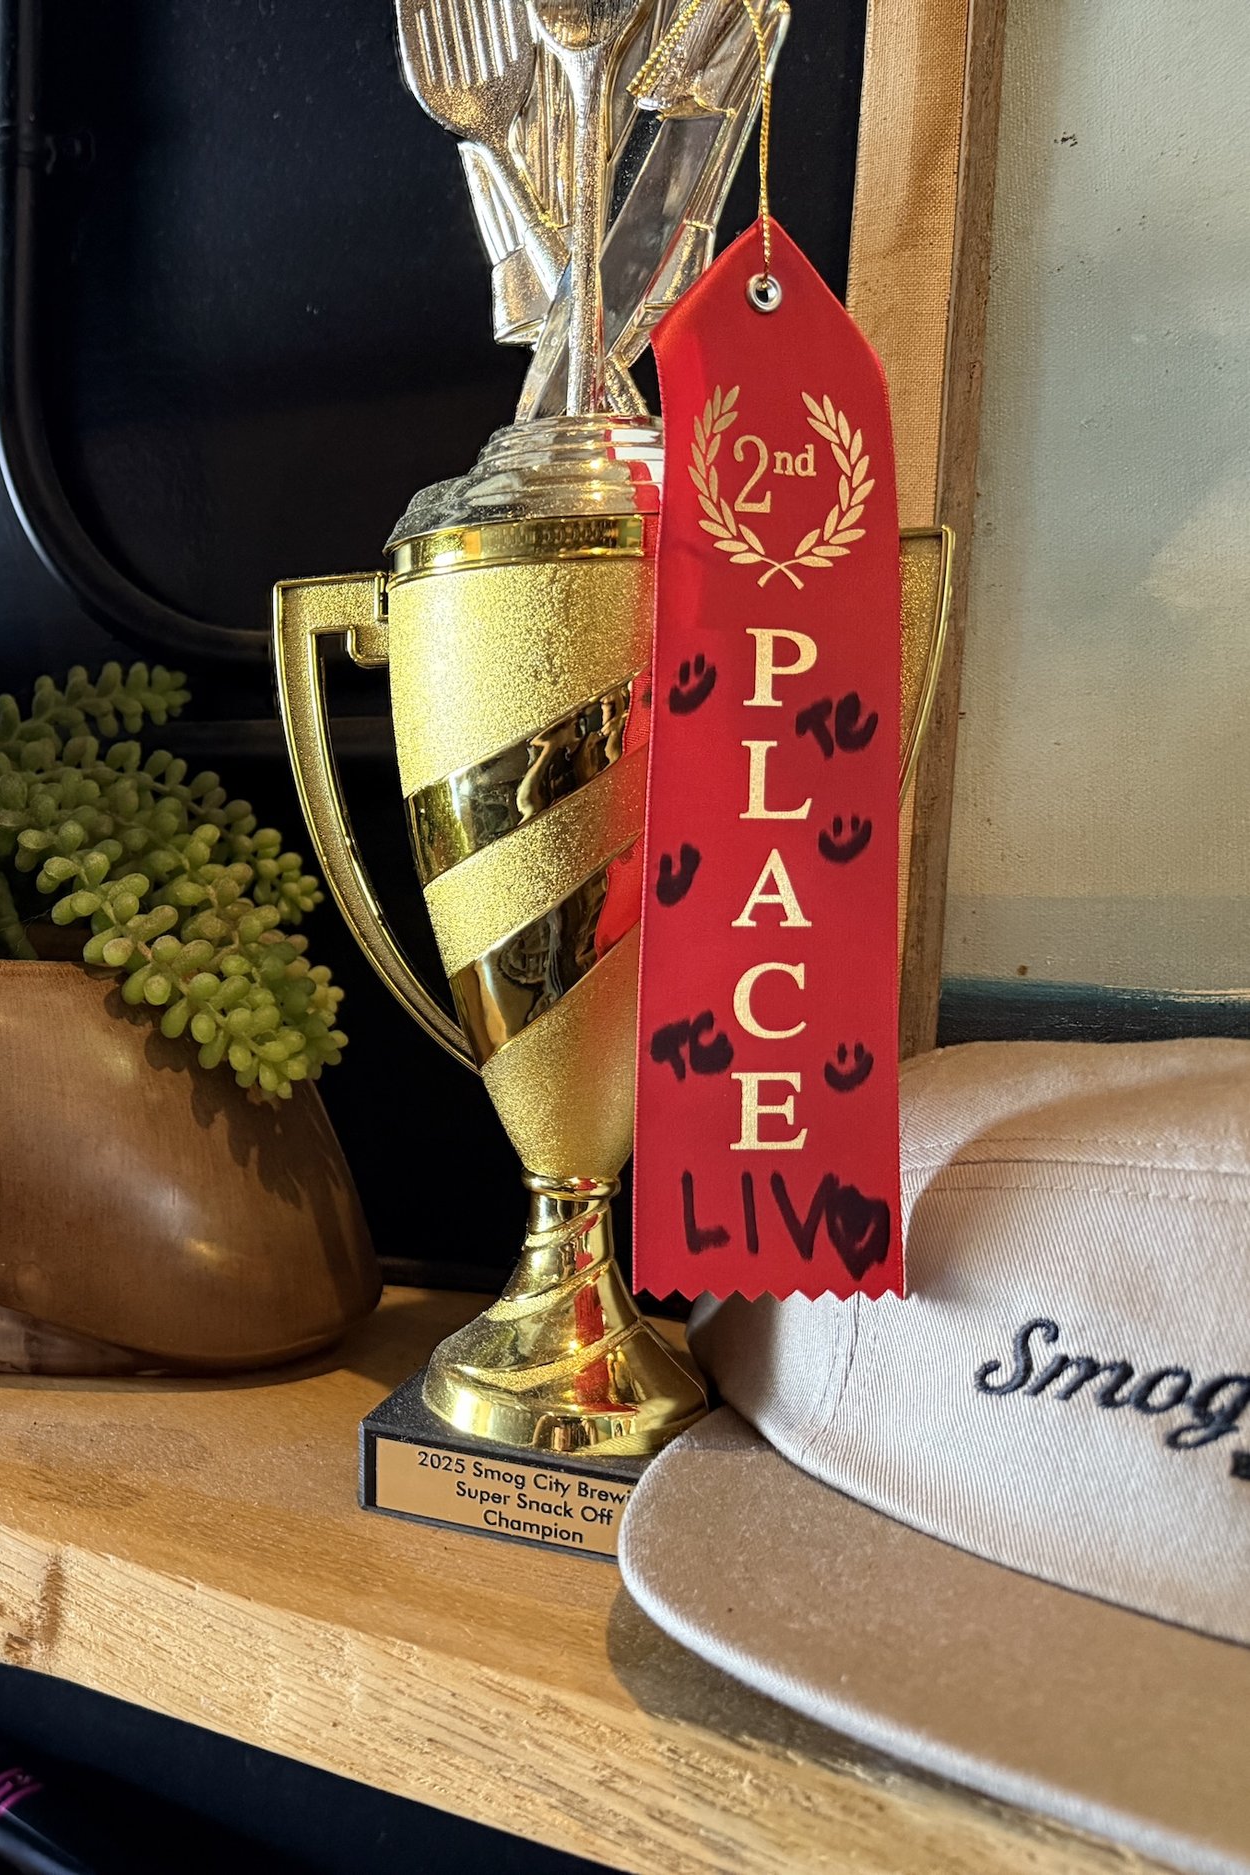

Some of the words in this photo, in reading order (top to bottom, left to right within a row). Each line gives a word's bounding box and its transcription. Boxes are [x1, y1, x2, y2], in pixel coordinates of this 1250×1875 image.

[732, 434, 817, 513] 2nd
[730, 627, 817, 1150] PLACE
[973, 1317, 1250, 1451] Smog
[416, 1450, 466, 1475] 2025
[472, 1461, 526, 1490] Smog
[532, 1473, 571, 1498] City
[455, 1480, 511, 1504] Super
[516, 1493, 574, 1519] Snack
[580, 1506, 614, 1526] Off
[482, 1509, 584, 1544] Champion
